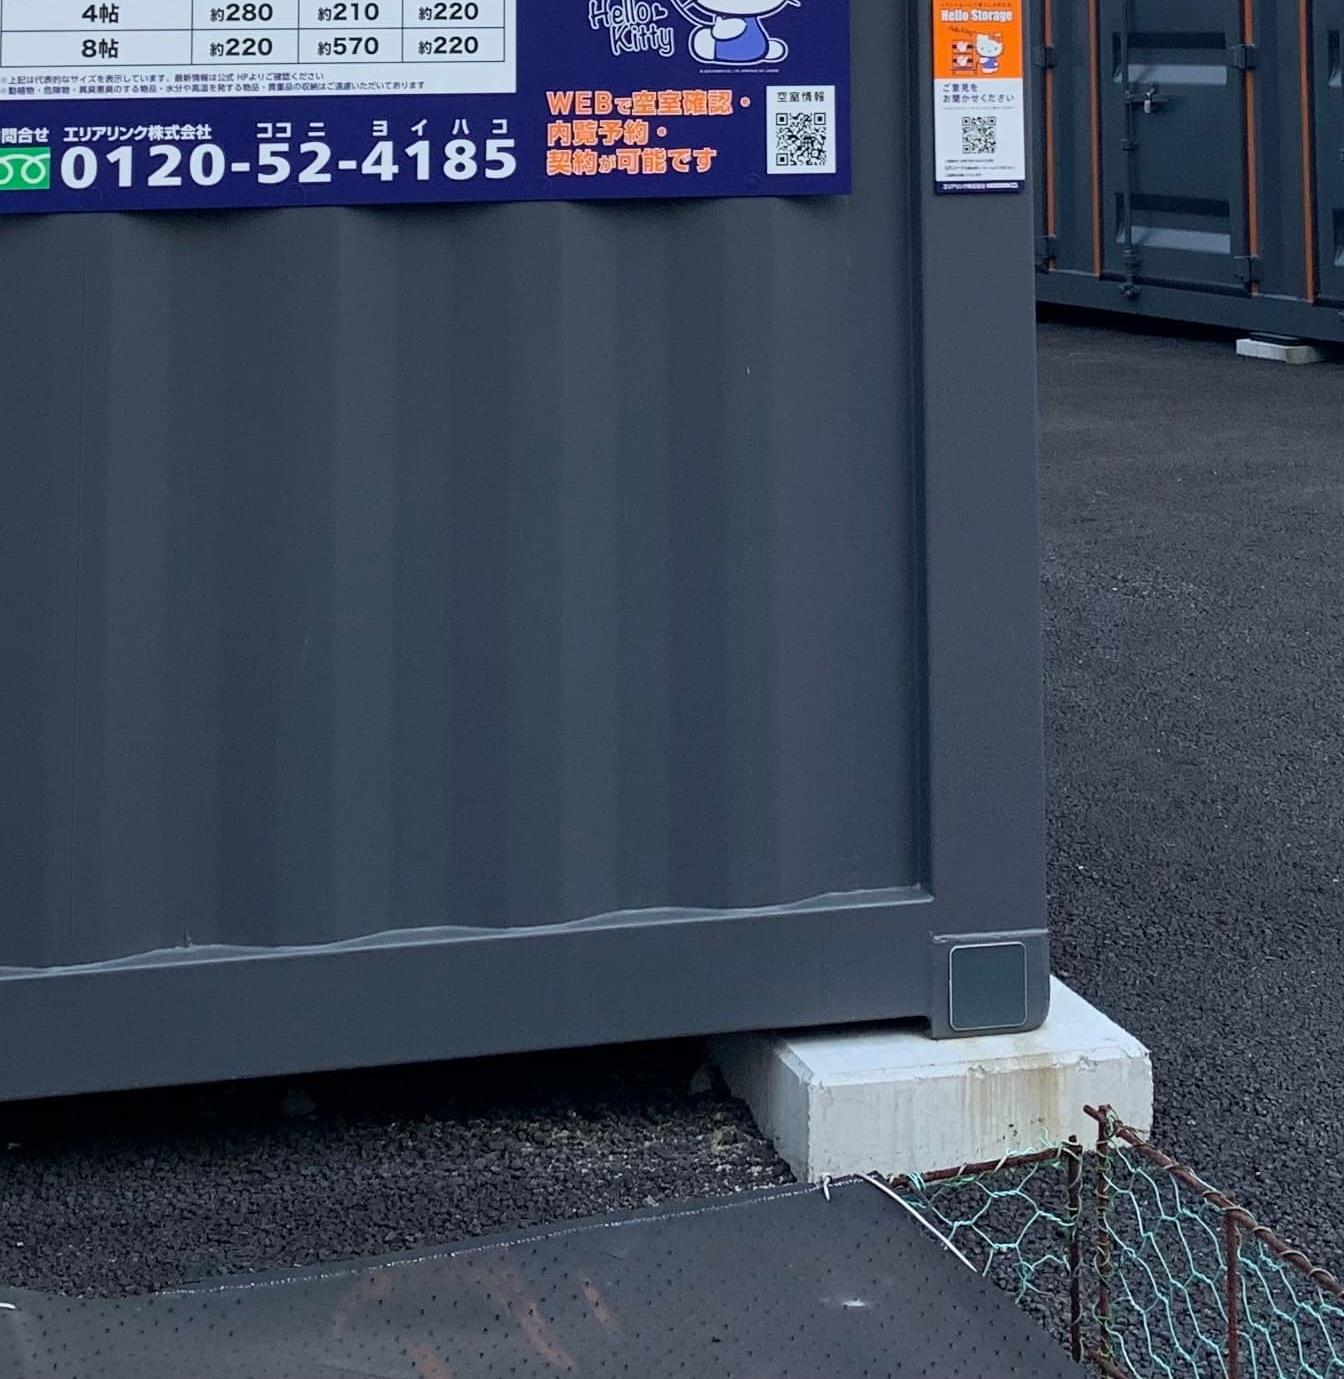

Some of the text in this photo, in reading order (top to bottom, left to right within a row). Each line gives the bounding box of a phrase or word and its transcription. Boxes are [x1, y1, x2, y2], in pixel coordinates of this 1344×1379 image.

[81, 2, 479, 24] 4帖 約280 約210 約220
[940, 9, 1013, 22] Hello Storage
[81, 36, 479, 59] 8帖 約220 約570 約220
[610, 23, 675, 57] Kitty
[776, 91, 825, 103] 空室情報
[63, 124, 213, 142] エリアリンク株式会社
[60, 139, 518, 189] 0120-52-4185
[546, 148, 717, 176] 契約が可能です
